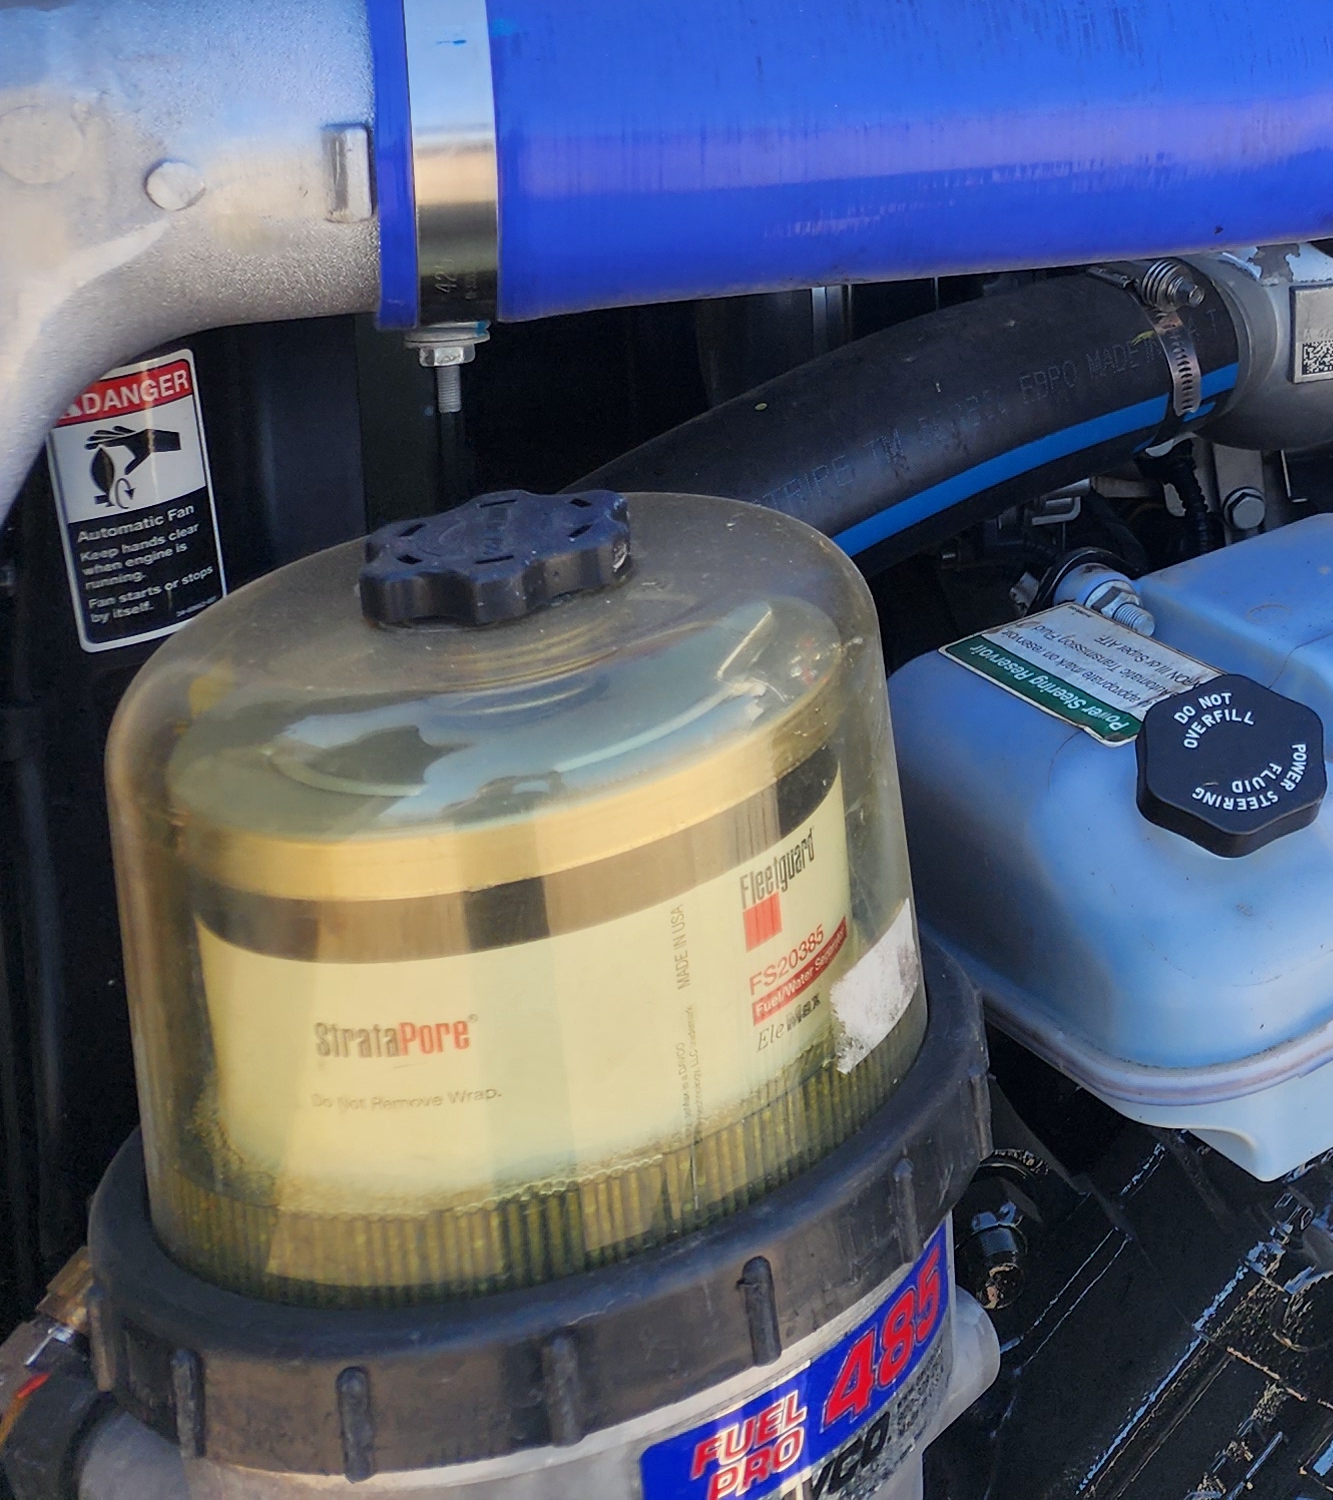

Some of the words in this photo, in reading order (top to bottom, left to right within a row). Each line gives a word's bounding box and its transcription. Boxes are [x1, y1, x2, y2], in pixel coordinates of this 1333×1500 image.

[79, 369, 190, 416] DANGER
[758, 455, 854, 510] TRIPE
[76, 515, 165, 544] Automatic
[167, 503, 195, 522] Fan
[80, 545, 120, 563] Keep
[121, 535, 166, 553] hands
[168, 523, 200, 542] clear
[81, 560, 123, 576] when
[125, 548, 173, 569] engine
[175, 541, 188, 553] is
[85, 572, 147, 591] running.
[88, 597, 116, 610] Fan
[118, 586, 162, 602] starts
[164, 580, 179, 593] or
[181, 565, 214, 587] stops
[89, 608, 111, 624] by
[112, 600, 155, 619] itself.
[1033, 624, 1063, 642] Fluid
[1094, 635, 1119, 649] ATF
[968, 642, 1034, 683] Reservoir
[1045, 652, 1059, 663] on
[1058, 657, 1085, 676] mark
[1061, 634, 1123, 673] Transmission
[1115, 642, 1150, 665] Super
[1149, 659, 1161, 669] or
[1029, 674, 1086, 711] Steering
[1082, 670, 1141, 705] appropriate
[1118, 665, 1171, 699] Automatic
[1082, 703, 1130, 732] Power
[1173, 701, 1197, 726] DO
[1197, 691, 1233, 716] NOT
[1183, 707, 1256, 750] OVERFILL
[1230, 762, 1283, 795] FLUID
[1279, 743, 1308, 793] POWER
[1191, 786, 1280, 811] STEERING
[739, 826, 815, 911] Fleetguard
[671, 904, 686, 934] USA
[673, 933, 687, 951] IN
[749, 923, 825, 996] FS20385
[674, 949, 692, 991] MADE
[754, 964, 814, 1017] Fuel/Water
[314, 1019, 471, 1059] StrataPore
[310, 1093, 333, 1108] Do
[336, 1096, 366, 1112] Not
[370, 1095, 444, 1111] Remove
[447, 1087, 502, 1105] Wrap.
[819, 1245, 942, 1434] 485
[689, 1389, 809, 1482] FUEL
[705, 1425, 805, 1500] PRO
